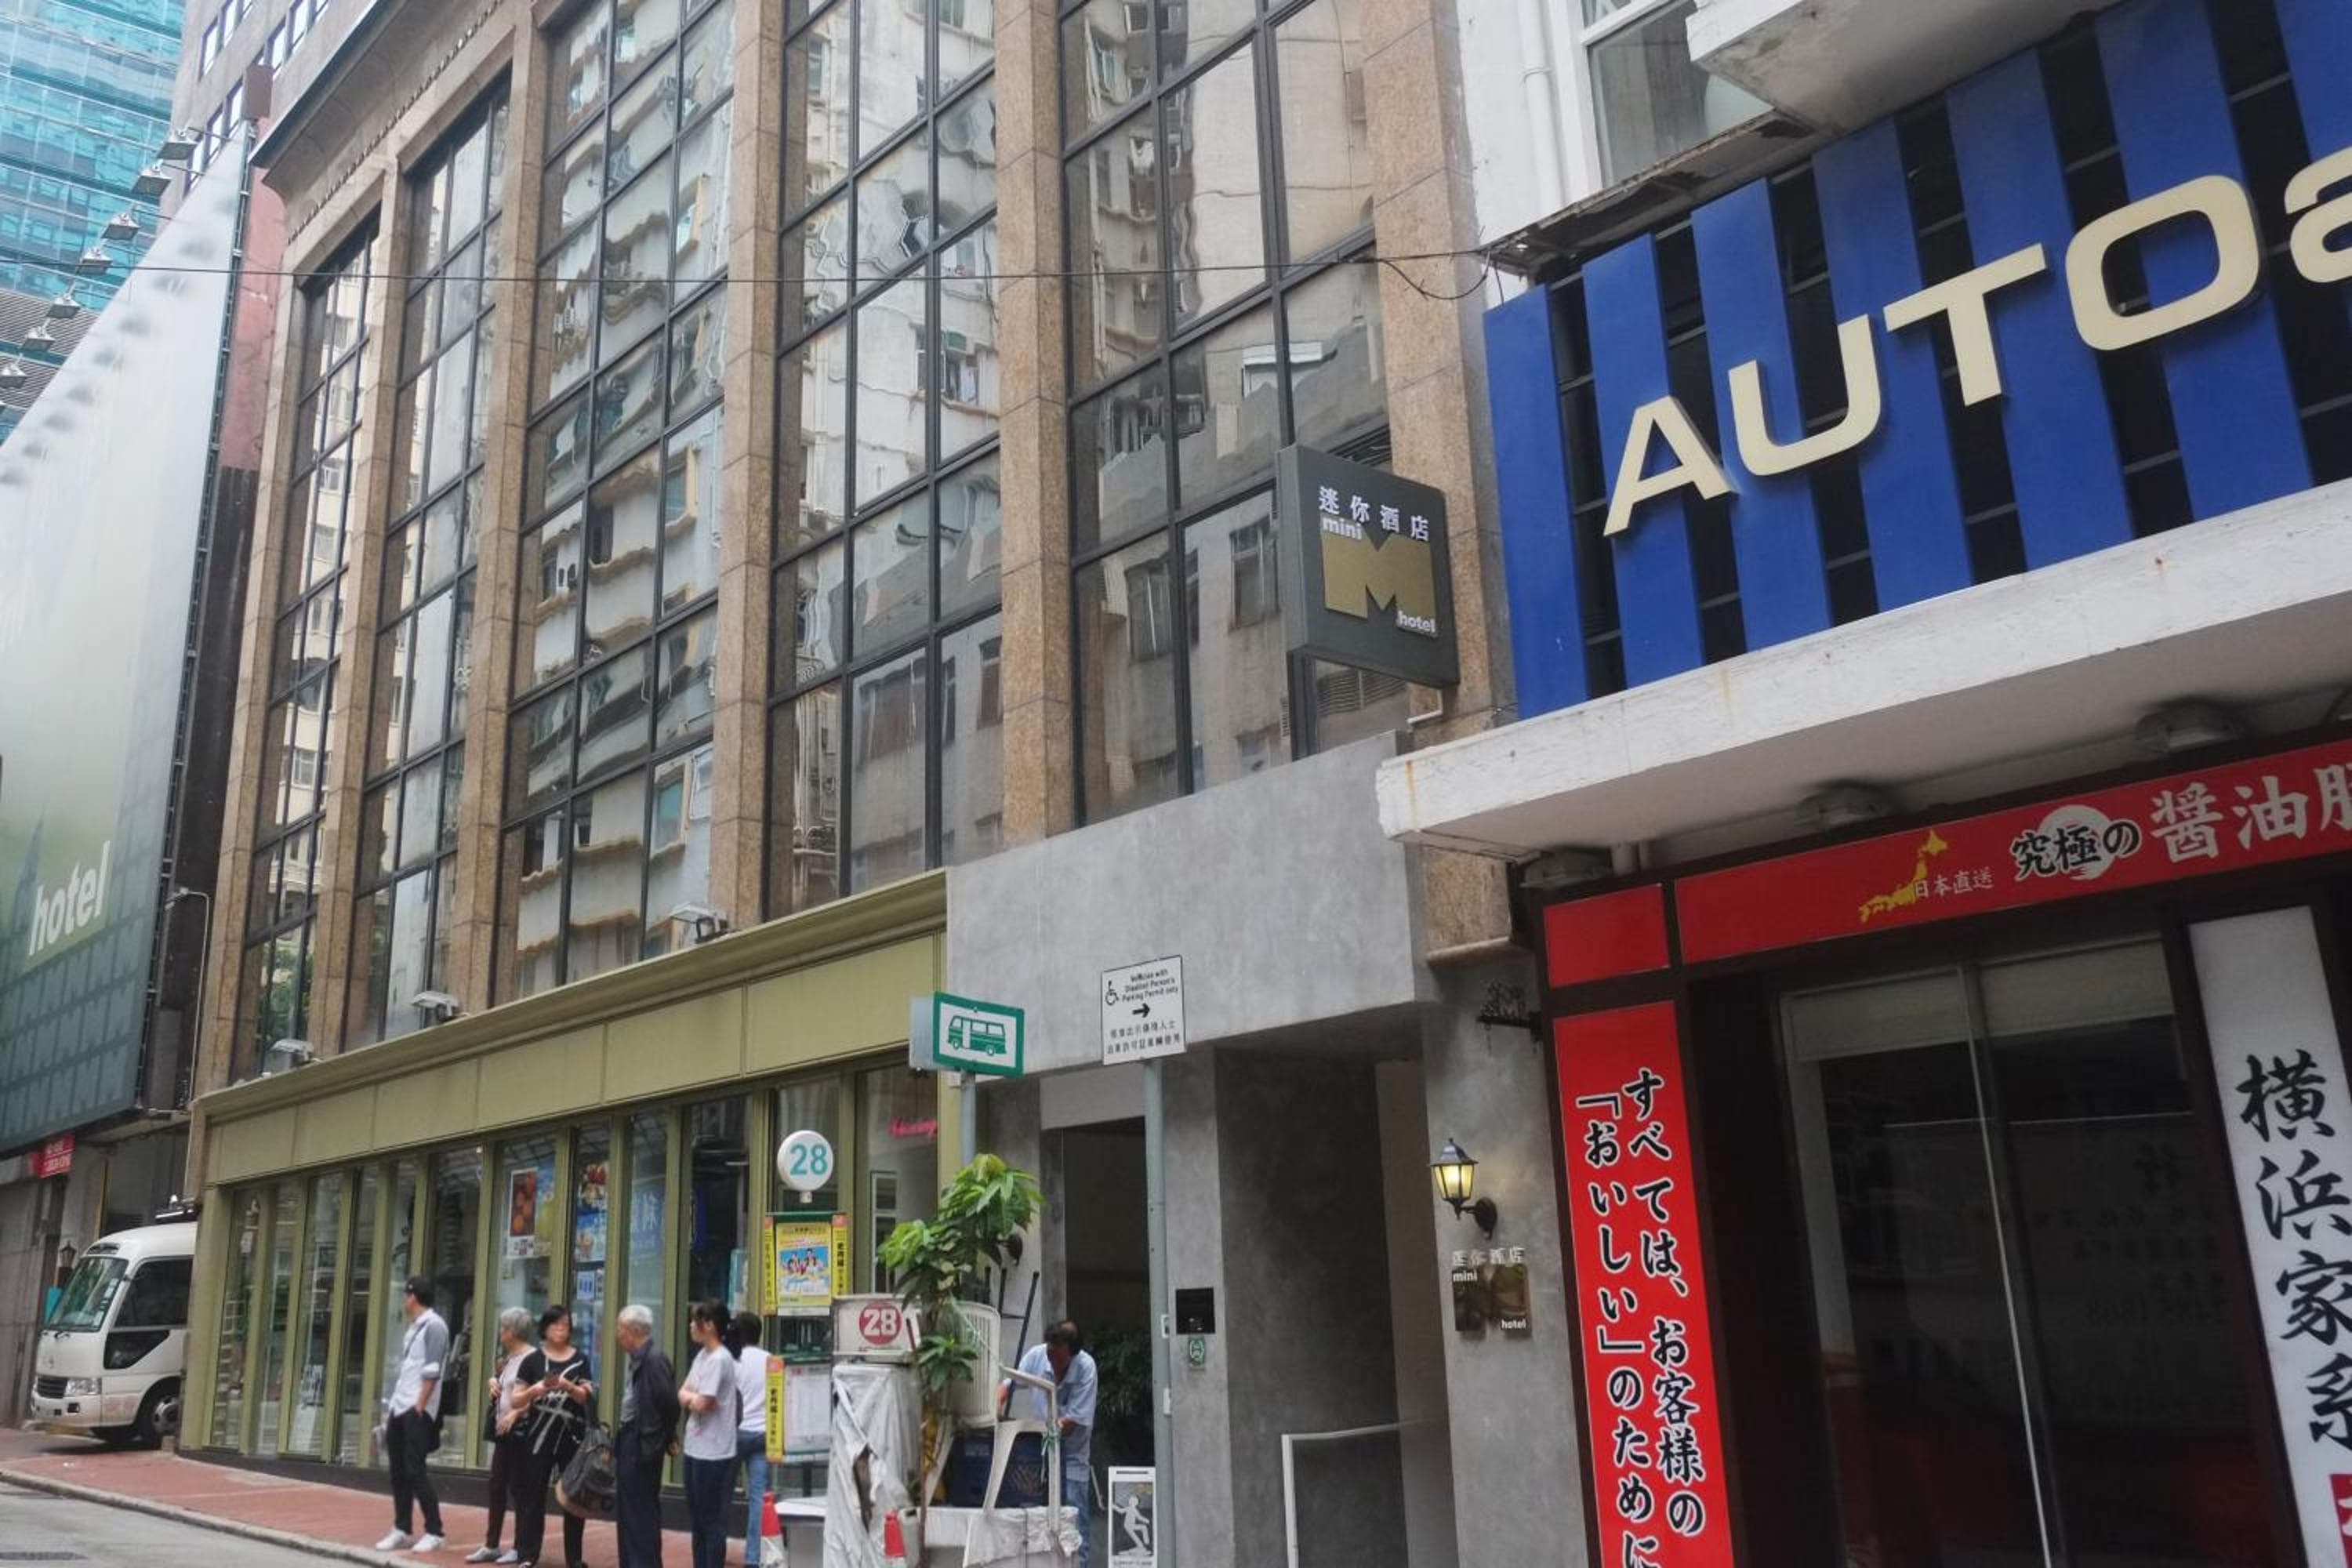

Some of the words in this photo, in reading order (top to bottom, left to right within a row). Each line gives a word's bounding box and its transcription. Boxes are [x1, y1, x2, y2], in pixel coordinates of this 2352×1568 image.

[1319, 485, 1430, 542] 迷你酒店
[1323, 515, 1363, 540] mini
[1396, 611, 1436, 633] hotel
[1915, 866, 1994, 898] 日本直送
[28, 840, 111, 956] hotel
[789, 1143, 829, 1176] 28
[1453, 1271, 1478, 1282] mini
[1622, 1068, 1706, 1537] すべては、お客様の
[862, 1308, 898, 1337] 28
[1501, 1319, 1526, 1330] hotel
